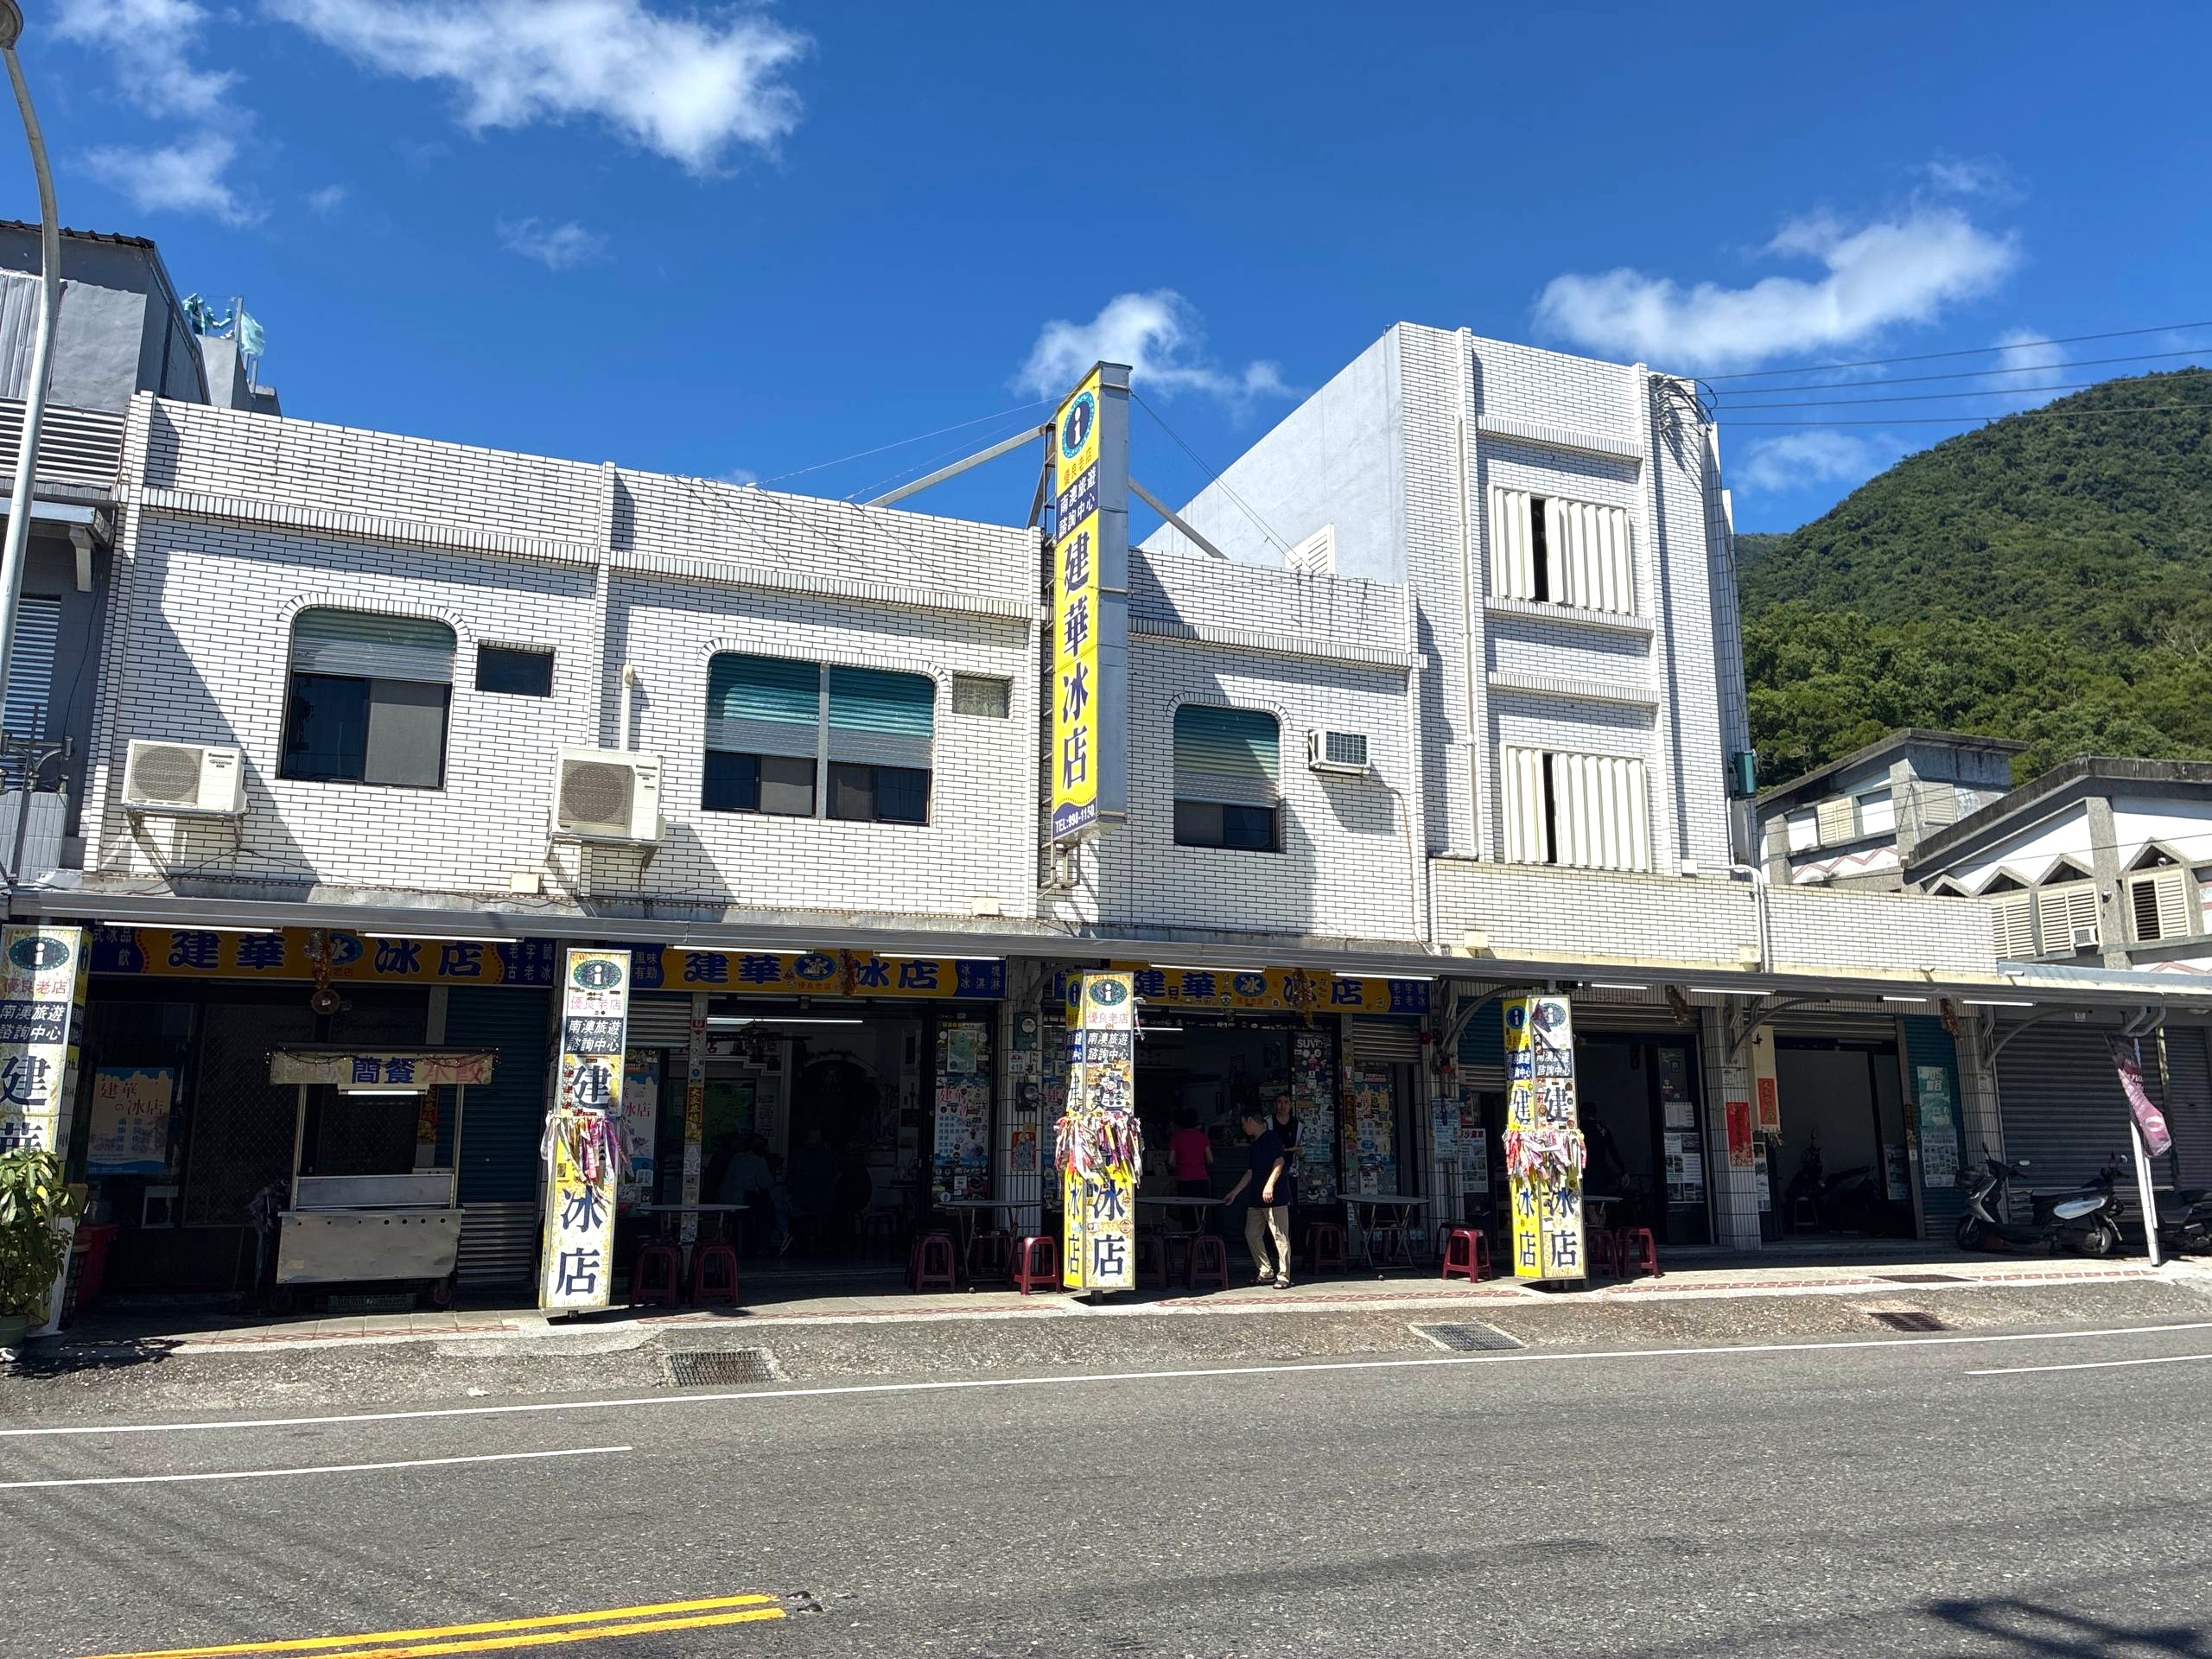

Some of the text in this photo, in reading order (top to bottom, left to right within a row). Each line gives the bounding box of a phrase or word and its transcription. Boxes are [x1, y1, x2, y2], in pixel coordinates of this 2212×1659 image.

[1064, 447, 1093, 486] 優良老店
[1060, 467, 1096, 517] 南澳旅遊
[1058, 493, 1096, 539] 諮詢中心
[1061, 531, 1090, 791] 建華冰店
[168, 931, 286, 970] 建華
[374, 938, 484, 976] 冰店
[684, 952, 782, 983] 建華
[7, 978, 68, 995] 優良老店
[570, 995, 621, 1010] 優良老店
[0, 1004, 65, 1022] 南澳旅遊
[1088, 1012, 1128, 1024] 優良老店
[0, 1023, 61, 1040] 諮詢中心
[568, 1020, 621, 1035] 南澳旅遊
[566, 1036, 620, 1052] 諮詢中心
[1087, 1032, 1129, 1046] 南澳旅遊
[1087, 1047, 1128, 1061] 諮詢中心
[351, 1056, 416, 1084] 簡餐
[101, 1082, 138, 1099] 建華
[114, 1098, 164, 1116] の冰店
[555, 1065, 613, 1296] 建冰店
